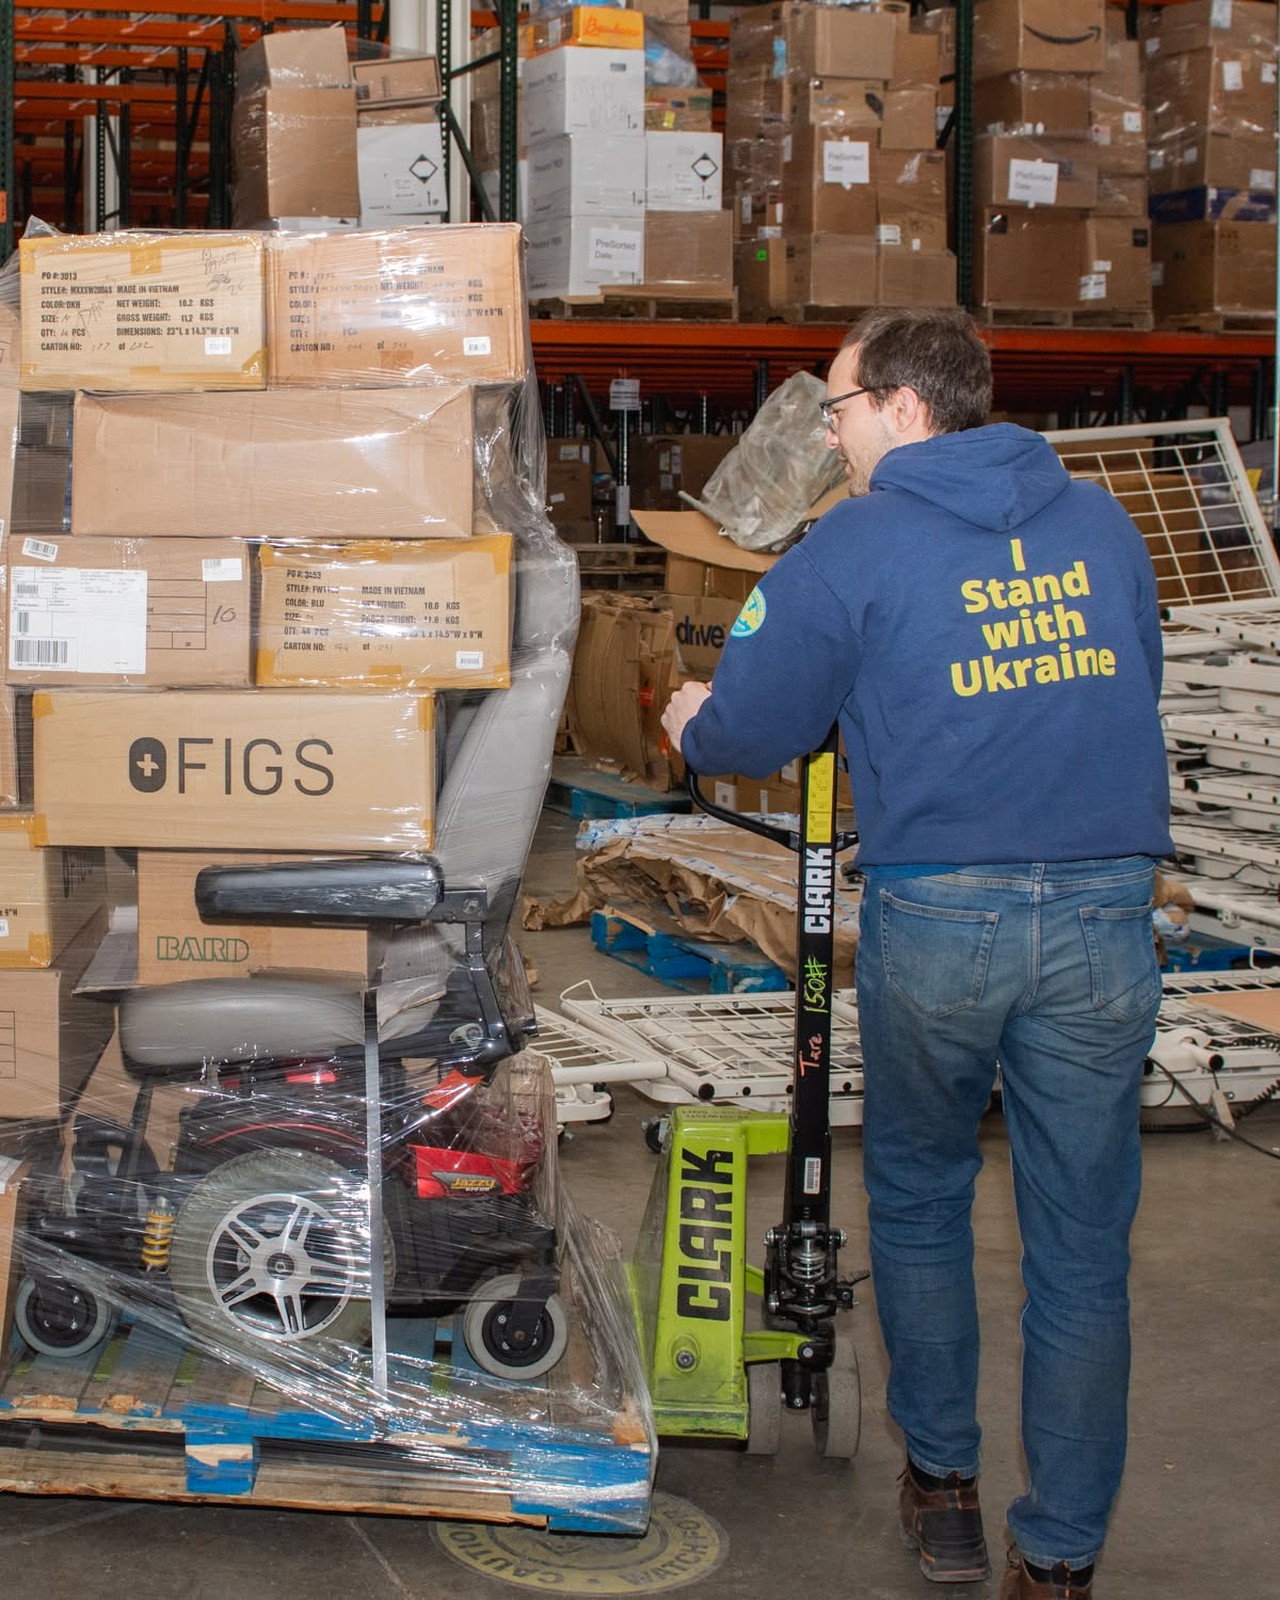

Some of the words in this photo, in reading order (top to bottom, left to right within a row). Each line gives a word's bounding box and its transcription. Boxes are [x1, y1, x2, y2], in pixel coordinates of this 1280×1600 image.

[596, 239, 636, 250] PreSorted
[41, 272, 51, 280] PO
[60, 272, 77, 281] 3013
[288, 271, 298, 279] PO
[468, 279, 483, 288] KGS
[41, 286, 68, 294] STYLE#:
[117, 285, 137, 293] MADE
[138, 285, 146, 293] IN
[148, 285, 180, 293] VIETNAM
[117, 299, 131, 307] NET
[132, 299, 161, 308] WEIGHT:
[200, 298, 214, 307] KGS
[468, 294, 483, 303] KGS
[41, 300, 66, 309] COLOR:
[289, 300, 317, 309] COLOR:
[41, 314, 58, 322] SIZE:
[117, 313, 140, 322] GROSS
[142, 313, 171, 322] WEIGHT:
[200, 312, 214, 321] KGS
[41, 328, 56, 337] QTY:
[71, 328, 86, 336] PCS
[117, 327, 163, 336] DIMENSIONS:
[41, 342, 68, 351] CARTON
[70, 342, 82, 351] NO:
[118, 342, 125, 351] of
[290, 343, 318, 352] CARTON
[320, 342, 336, 351] NO:
[1010, 538, 1026, 571] I
[286, 569, 296, 578] PO
[286, 584, 311, 592] STYLE#:
[361, 586, 382, 595] MADE
[384, 586, 392, 595] IN
[394, 587, 425, 596] VIETNAM
[961, 561, 1091, 613] Stand
[285, 598, 309, 607] COLOR:
[311, 599, 325, 608] BLU
[446, 602, 460, 610] KGS
[446, 616, 460, 624] KGS
[284, 627, 298, 635] QTY:
[315, 627, 330, 636] PCS
[675, 615, 725, 648] drive
[982, 604, 1087, 650] with
[283, 642, 311, 650] CARTON
[313, 643, 325, 651] NO:
[362, 642, 370, 651] of
[950, 642, 1116, 697] Ukraine
[178, 738, 334, 796] FIGS
[804, 848, 832, 934] CLARK
[156, 936, 250, 962] BARD
[451, 1178, 496, 1189] Jazzy
[677, 1148, 733, 1321] CLARK
[447, 1523, 564, 1584] CAUTIO
